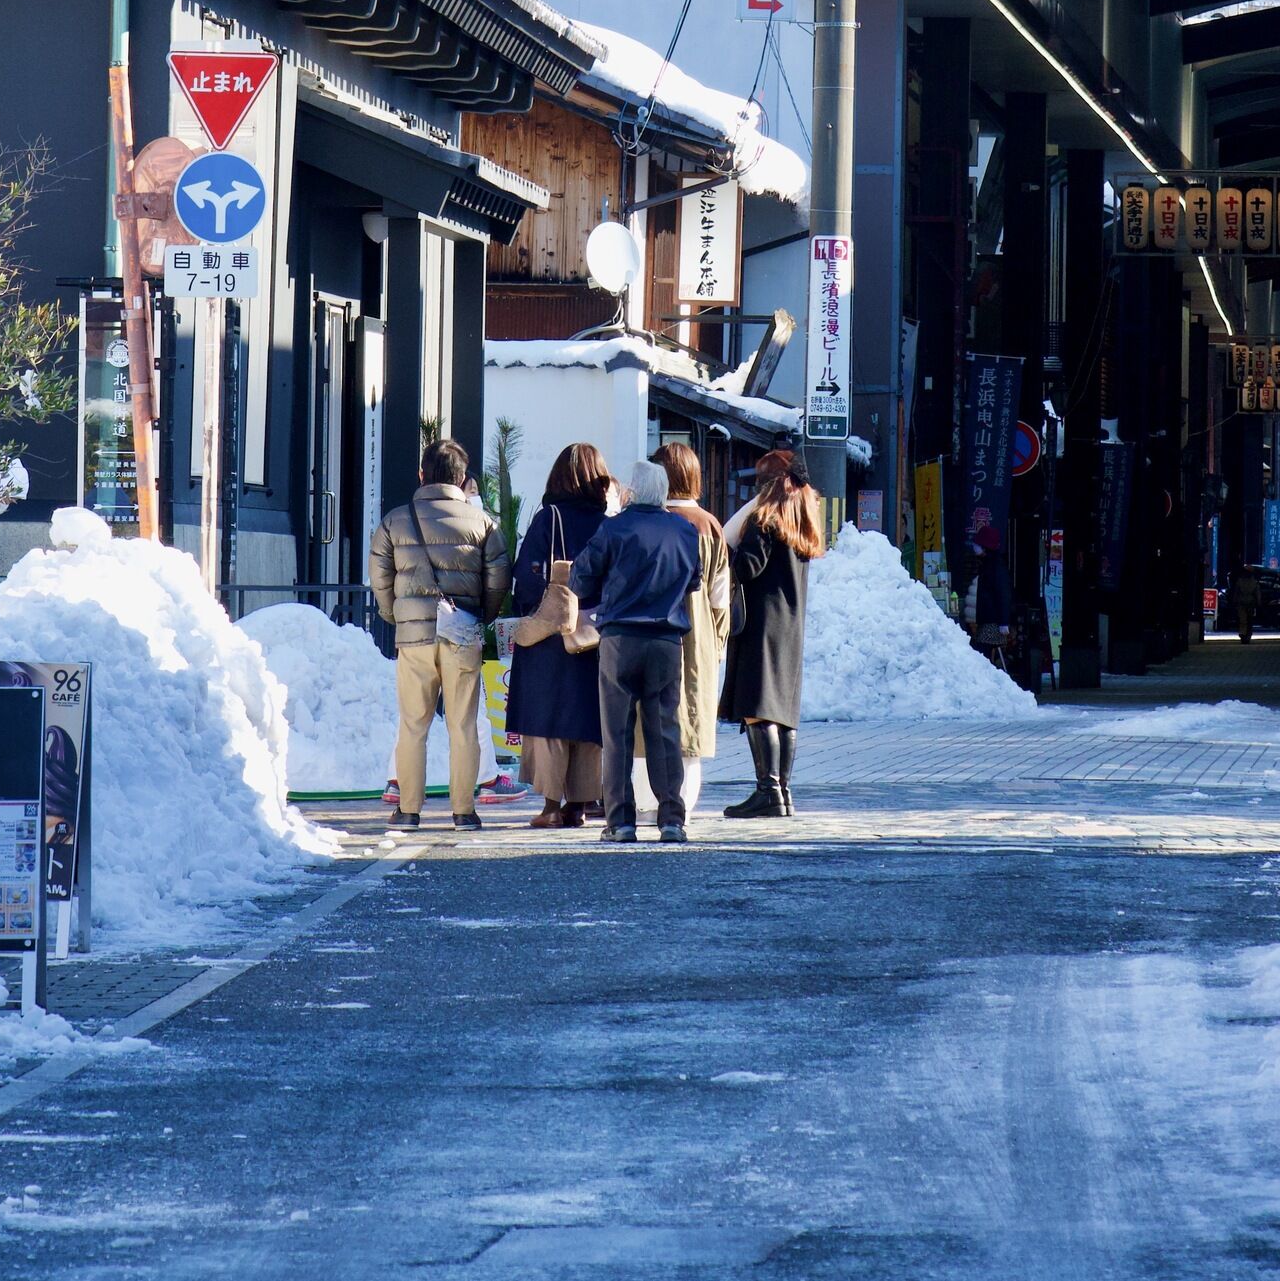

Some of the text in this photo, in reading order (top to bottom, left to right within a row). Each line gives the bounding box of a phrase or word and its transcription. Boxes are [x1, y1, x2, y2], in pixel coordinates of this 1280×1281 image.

[190, 70, 256, 94] 止まれ
[1160, 196, 1176, 239] 十日戎
[1193, 197, 1208, 240] 十日戎
[1224, 196, 1238, 240] 十日戎
[1250, 197, 1265, 240] 十日戎
[173, 251, 250, 271] 自動車
[696, 188, 718, 296] 近江牛まん本舗
[186, 272, 236, 295] 7-19
[821, 261, 840, 381] 長濱浪漫ビール
[112, 373, 128, 437] 北国街道
[54, 669, 81, 692] 96
